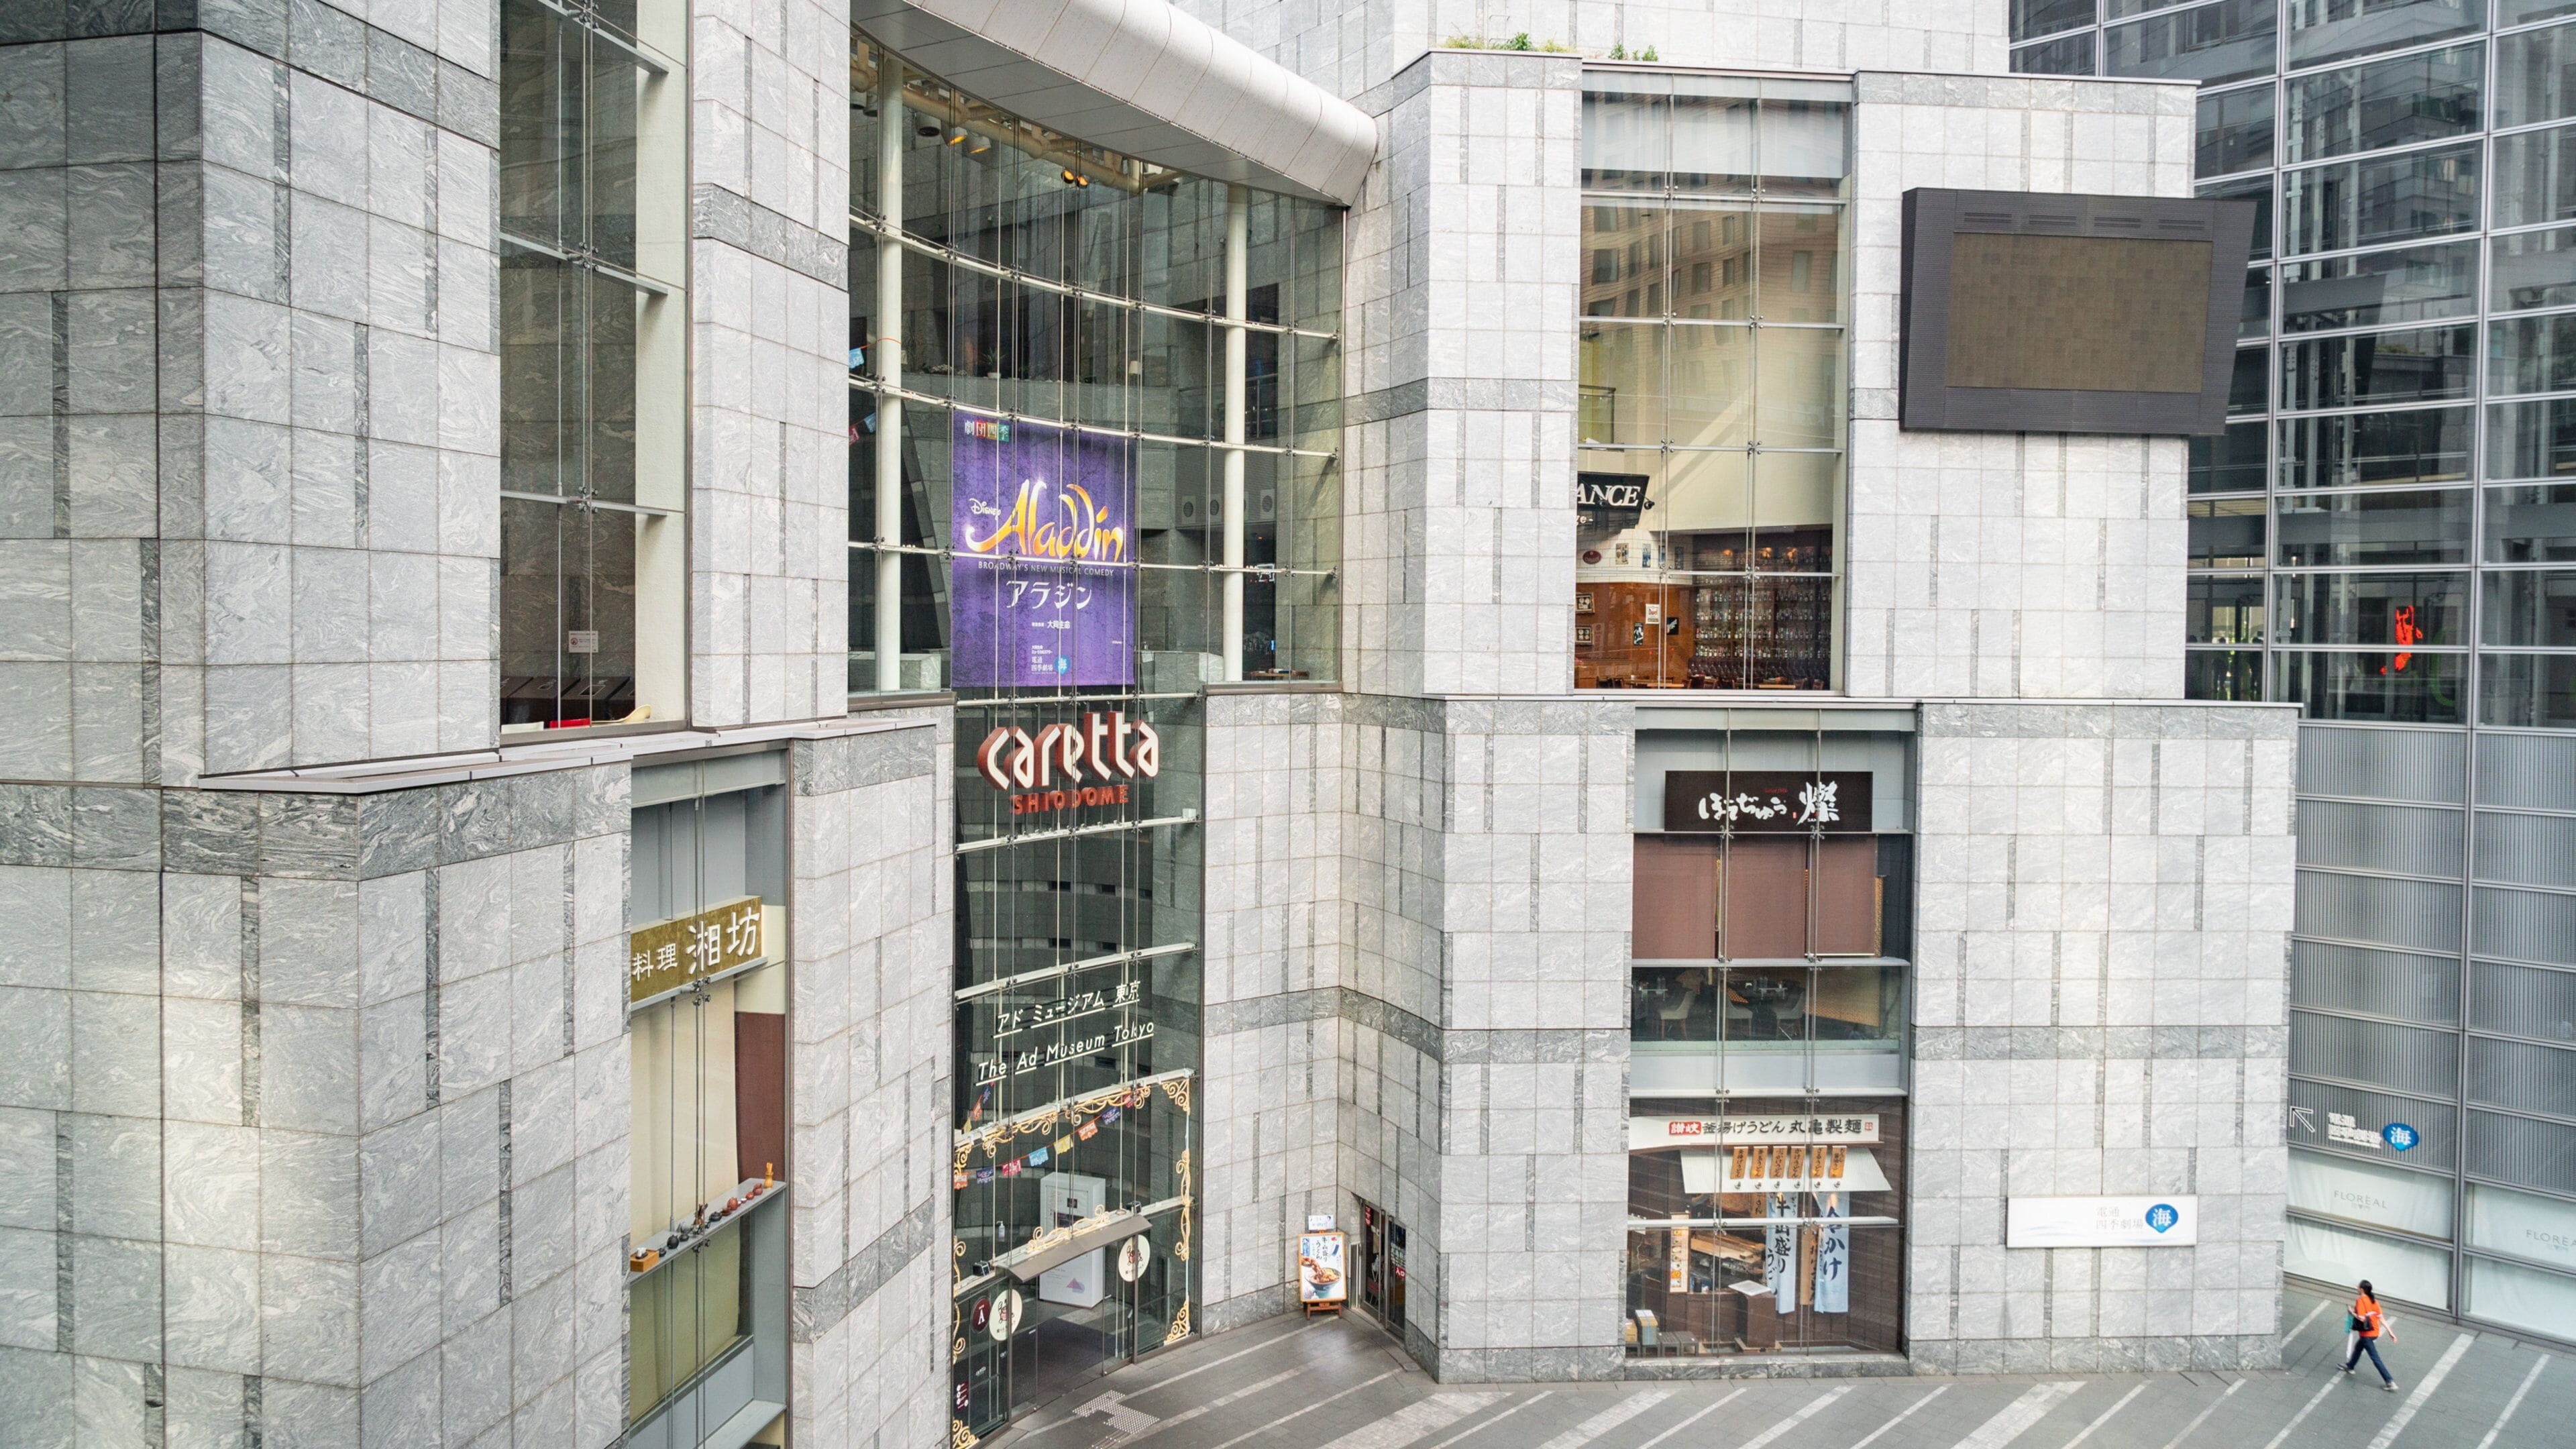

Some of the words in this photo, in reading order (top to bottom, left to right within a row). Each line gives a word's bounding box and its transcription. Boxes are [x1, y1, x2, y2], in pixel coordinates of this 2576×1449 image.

[965, 420, 1009, 441] 劇団四季
[964, 478, 1124, 563] Aladdin
[978, 560, 1028, 572] BROADWAY'S
[1030, 564, 1048, 572] NEW
[1050, 566, 1081, 575] MUSICAL
[1084, 568, 1114, 577] COMEDY
[1006, 580, 1092, 610] アラジン
[1010, 784, 1129, 815] SHIODOME
[632, 943, 678, 981] 料理
[686, 906, 760, 975] 湘坊
[998, 1008, 1024, 1033] アド
[1034, 991, 1105, 1022] ミュージアム
[1115, 980, 1141, 1003] 東京
[979, 1061, 1007, 1081] The
[1016, 1047, 1038, 1071] Ad
[1046, 1034, 1106, 1061] Museum
[1114, 1021, 1155, 1044] Tokyo
[1703, 1121, 1785, 1134] 釜揚げうどん
[2390, 1126, 2411, 1145] 海
[2152, 1208, 2172, 1228] 海
